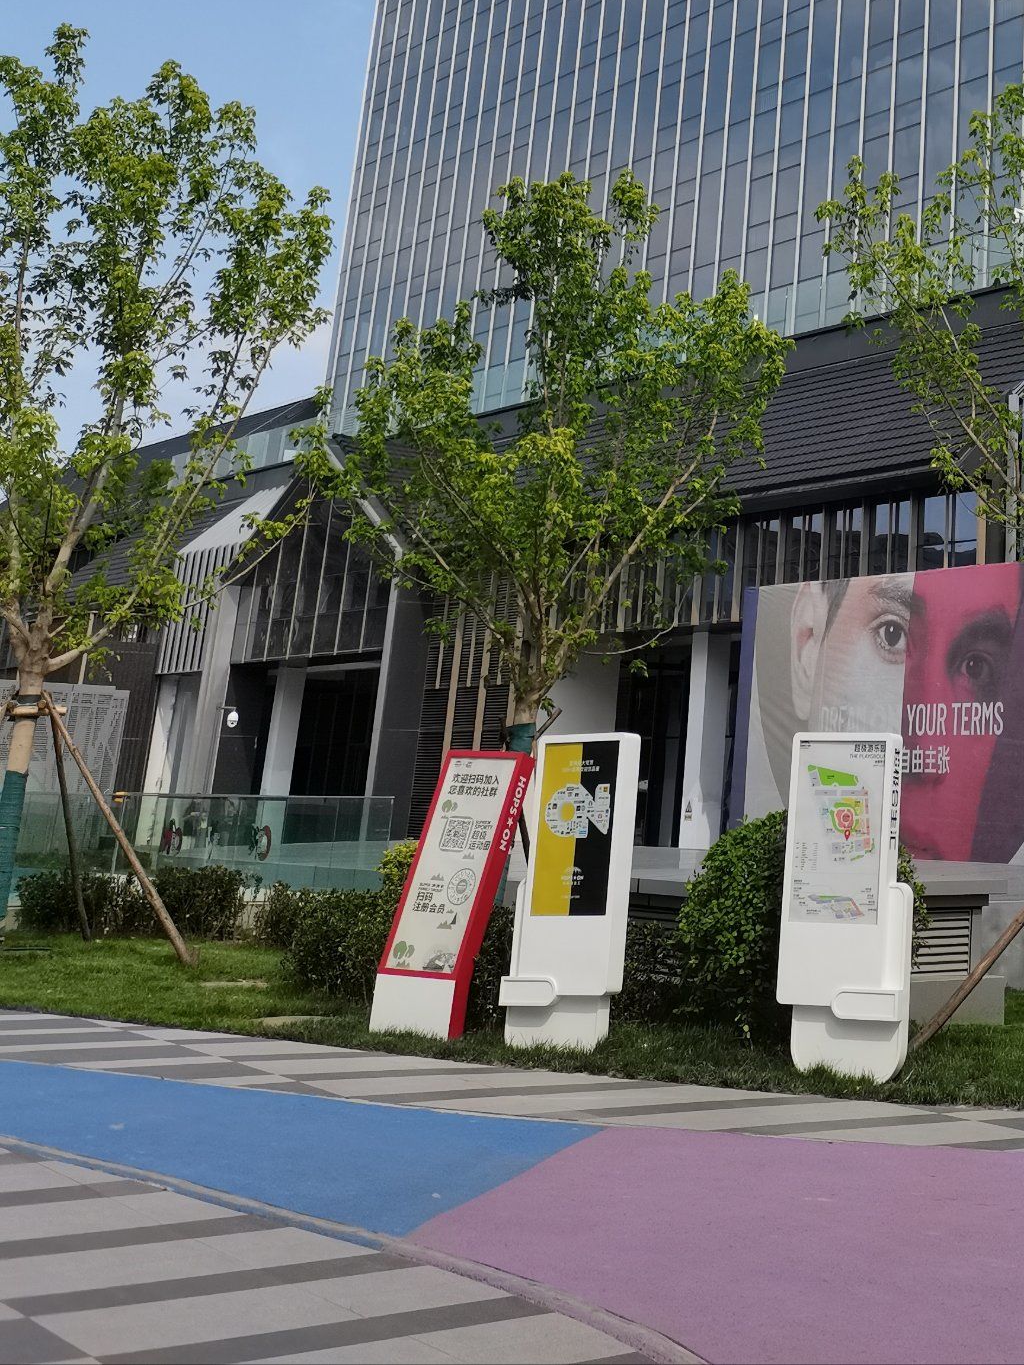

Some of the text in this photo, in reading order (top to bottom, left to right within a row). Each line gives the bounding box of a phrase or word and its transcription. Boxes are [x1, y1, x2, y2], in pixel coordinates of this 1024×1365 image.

[907, 703, 947, 736] YOUR
[952, 702, 1004, 736] TERMS
[452, 773, 499, 785] 欢迎扫码加入
[448, 785, 499, 797] 您喜欢的社群
[416, 891, 434, 903] 扫码
[412, 901, 446, 914] 注册会员
